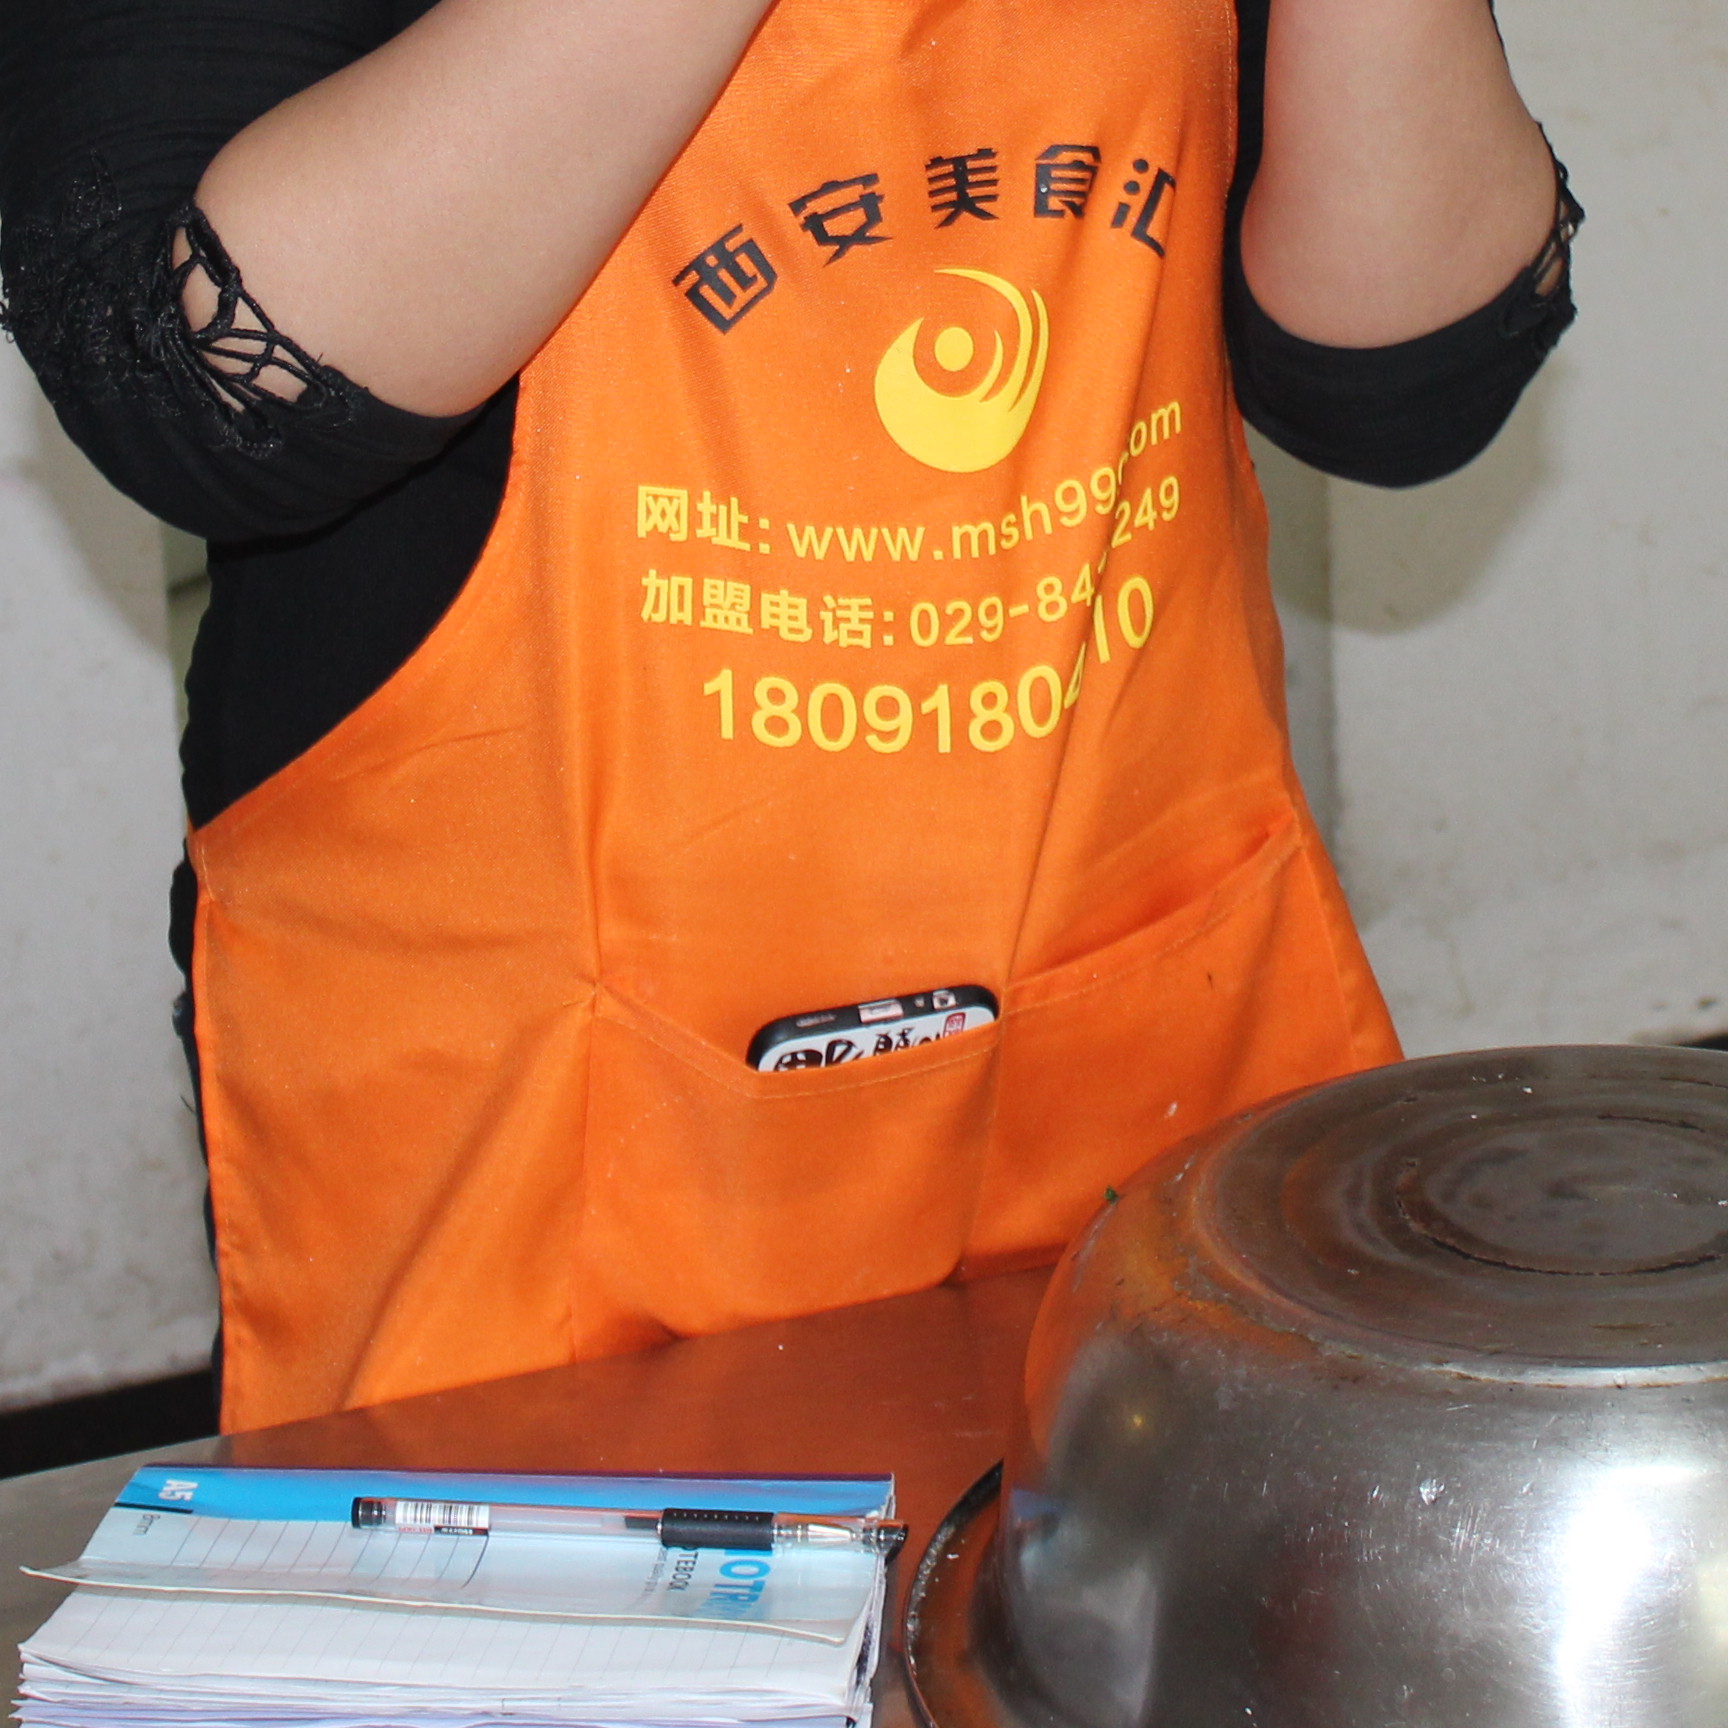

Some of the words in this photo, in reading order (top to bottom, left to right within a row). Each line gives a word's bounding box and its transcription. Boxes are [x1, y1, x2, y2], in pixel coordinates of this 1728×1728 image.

[673, 144, 1177, 335] 西安美食汇
[158, 1479, 199, 1501] A5
[667, 1548, 699, 1591] TEBOOK
